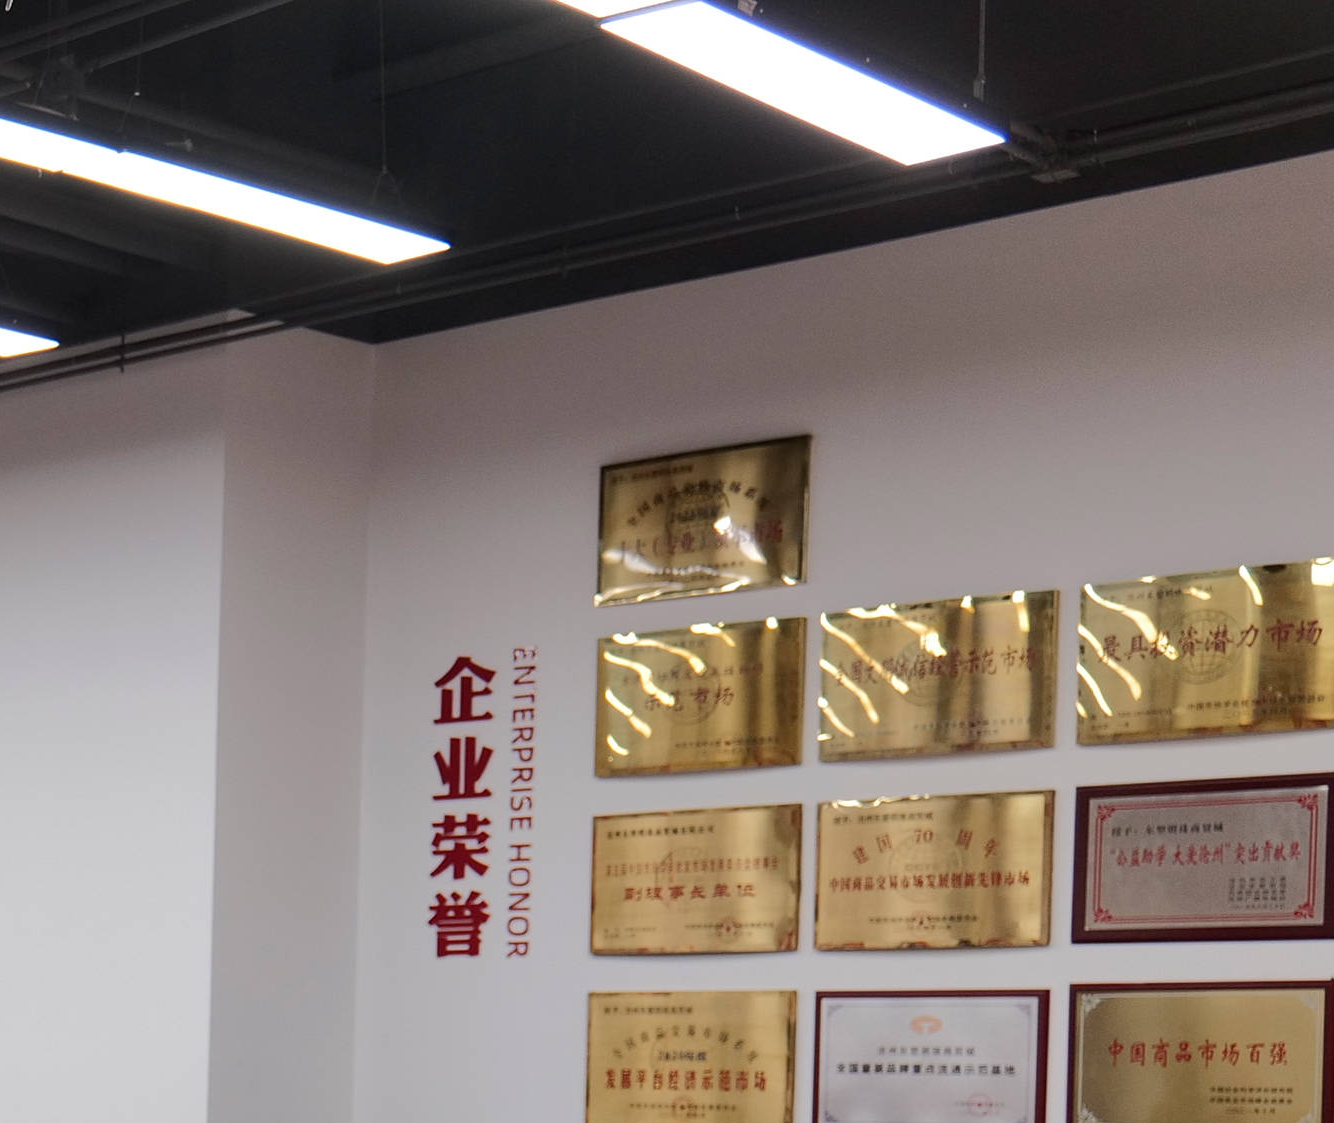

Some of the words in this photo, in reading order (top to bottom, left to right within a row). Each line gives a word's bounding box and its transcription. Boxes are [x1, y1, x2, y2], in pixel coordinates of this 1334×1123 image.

[428, 656, 497, 958] 企业荣誉
[508, 646, 537, 832] ENTERPRISE
[506, 843, 532, 959] HONOR
[1108, 1037, 1289, 1069] 中国商品市场百强
